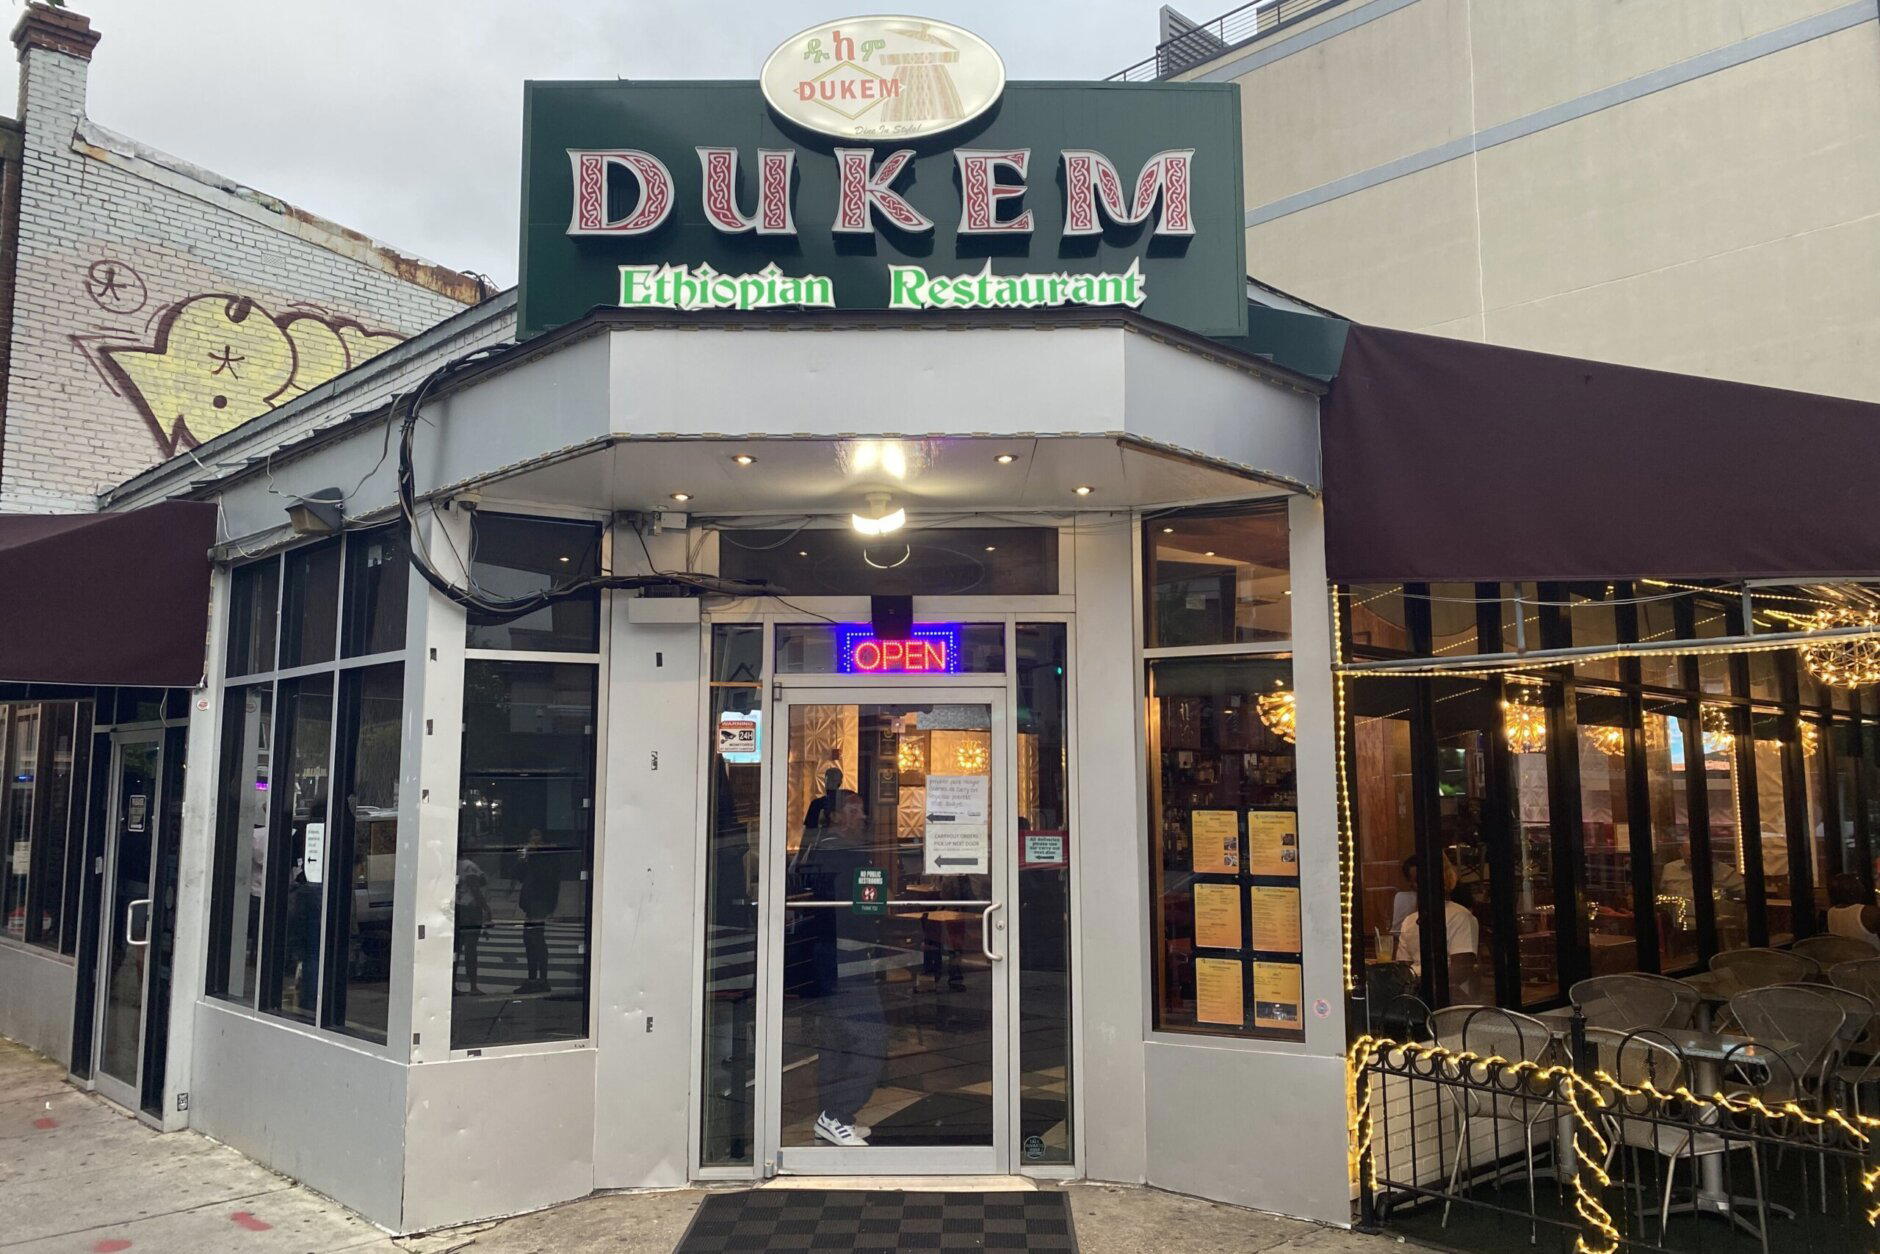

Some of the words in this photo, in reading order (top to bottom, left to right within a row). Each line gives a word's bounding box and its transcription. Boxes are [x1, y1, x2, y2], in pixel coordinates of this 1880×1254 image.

[799, 78, 902, 101] DUKEM
[566, 147, 1196, 237] DUKEM
[618, 261, 836, 311] Ethiopian
[888, 256, 1147, 310] Restaurant
[855, 641, 946, 670] OPEN
[740, 731, 753, 740] 24H
